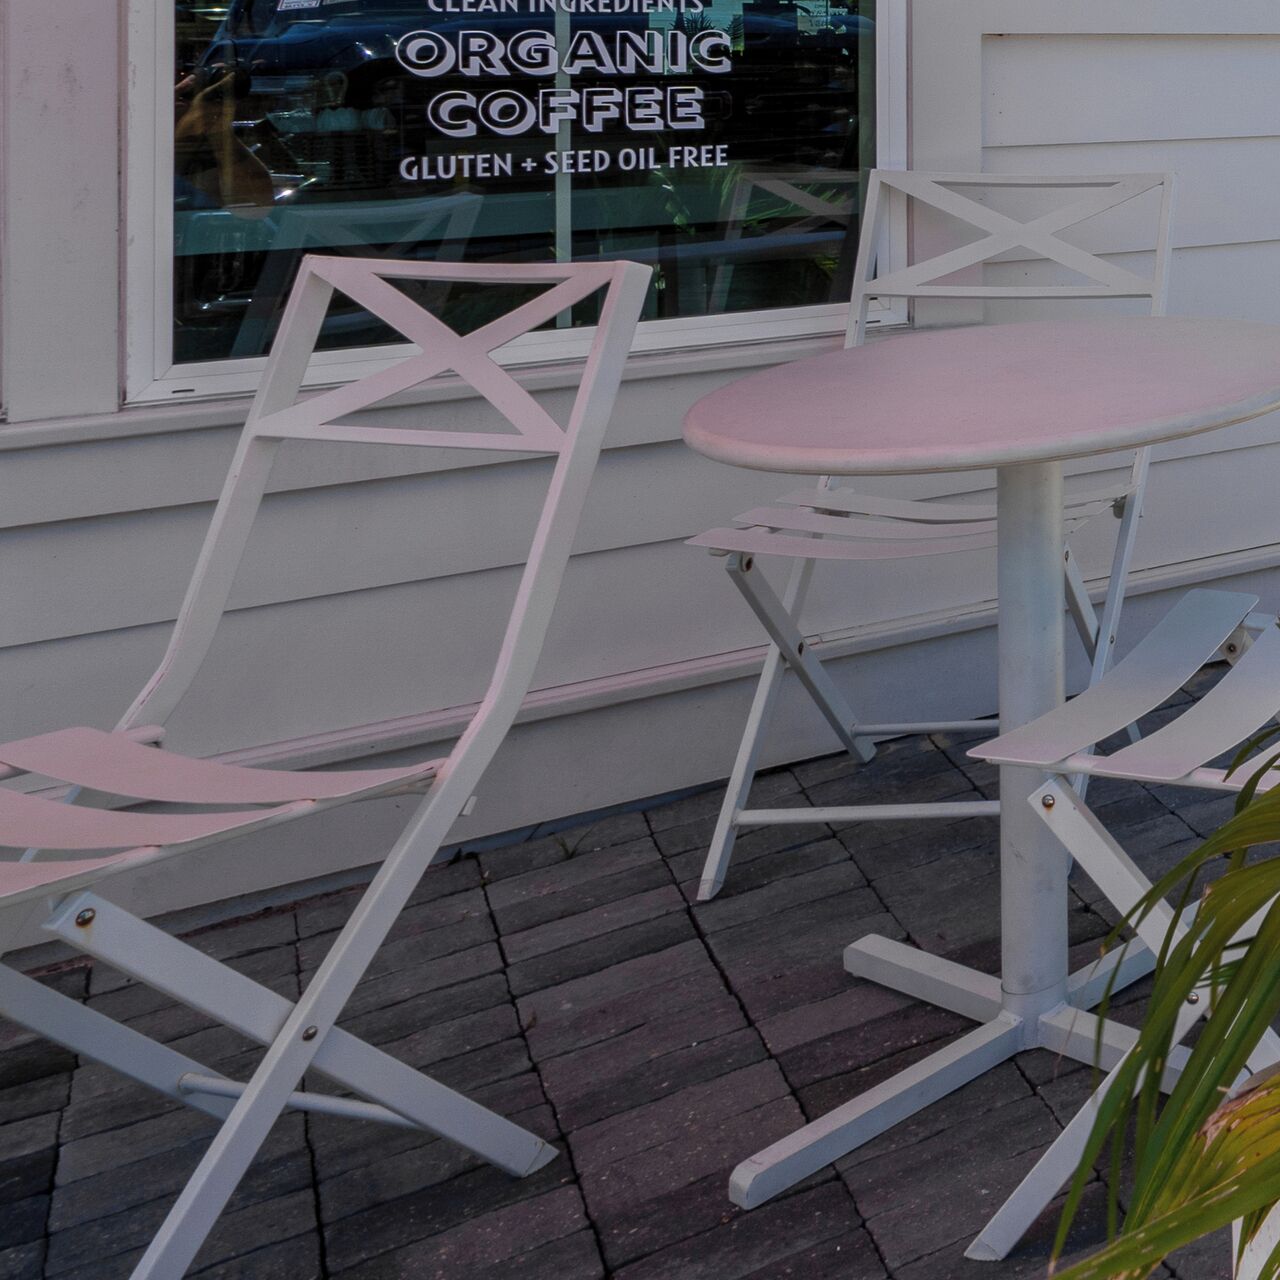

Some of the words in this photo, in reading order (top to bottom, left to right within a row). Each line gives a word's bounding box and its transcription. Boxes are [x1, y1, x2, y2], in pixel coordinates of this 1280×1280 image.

[395, 29, 732, 78] ORGANIC
[427, 86, 706, 138] COFFEE
[400, 152, 513, 182] GLUTEN
[544, 148, 610, 174] SEED
[622, 147, 661, 171] OIL
[669, 144, 729, 168] FREE
